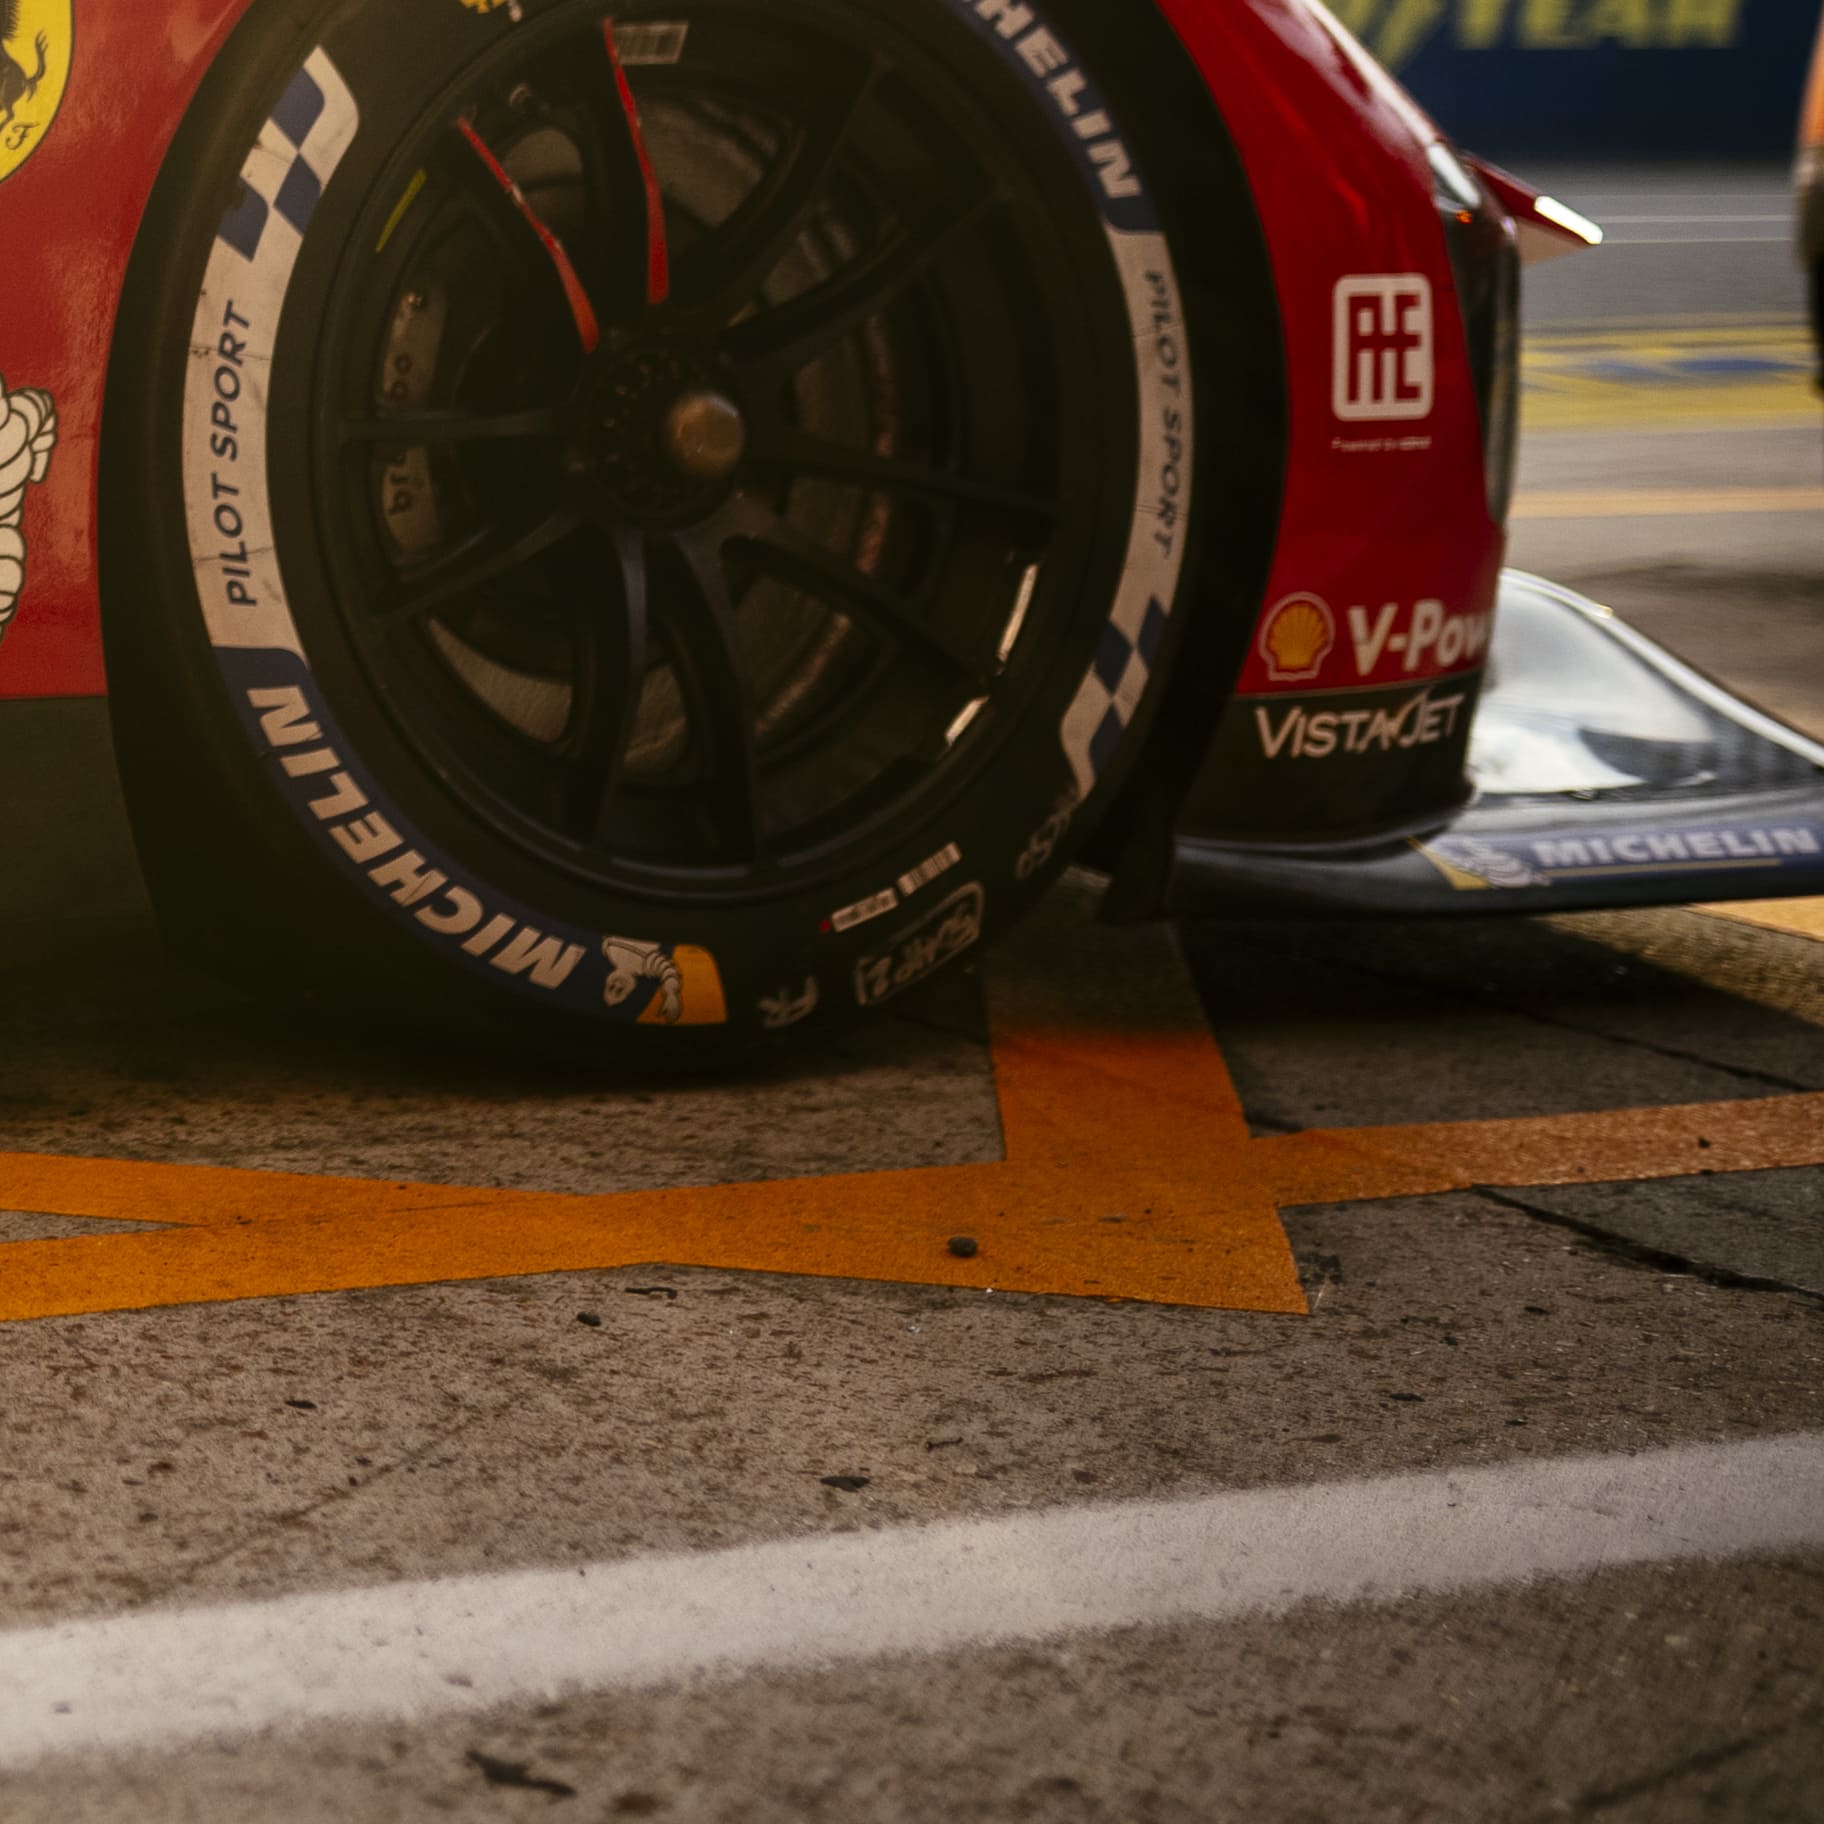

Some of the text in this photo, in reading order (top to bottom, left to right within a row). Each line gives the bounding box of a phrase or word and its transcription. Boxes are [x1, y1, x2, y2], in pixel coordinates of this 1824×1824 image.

[209, 299, 257, 607] PILOT SPORT
[1146, 269, 1182, 560] PILOT SPORT
[246, 684, 588, 991] MICHELIN
[1531, 828, 1821, 866] MICHELIN
